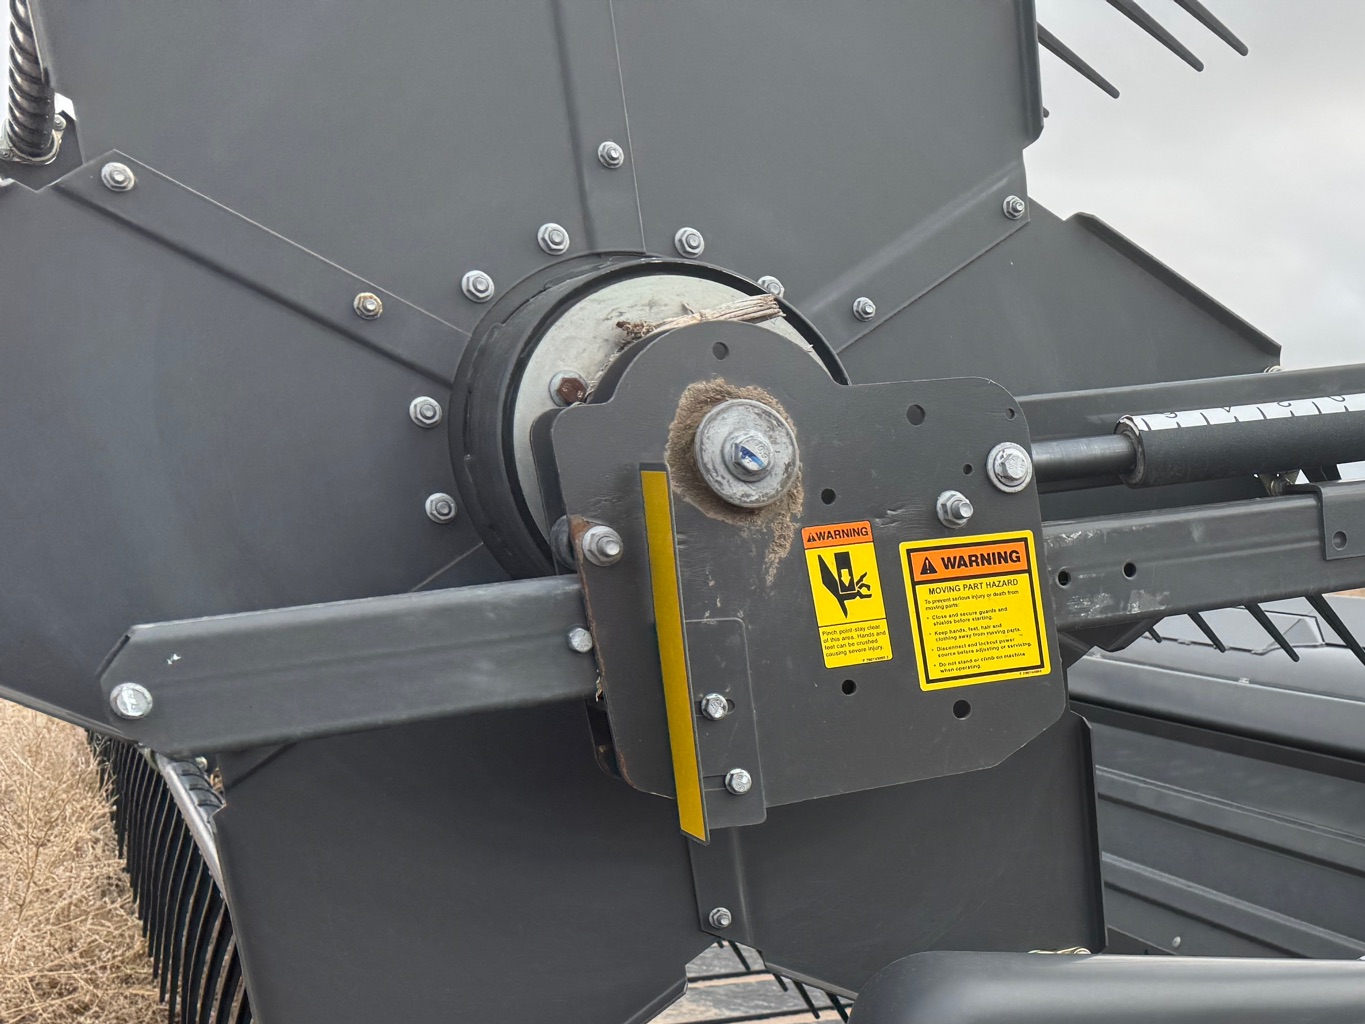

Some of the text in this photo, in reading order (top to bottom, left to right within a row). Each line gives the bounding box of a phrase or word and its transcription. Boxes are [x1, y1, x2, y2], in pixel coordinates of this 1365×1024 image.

[816, 527, 868, 540] WARNING
[940, 550, 1021, 570] WARNING
[929, 579, 1018, 595] MOVING PART HAZARD
